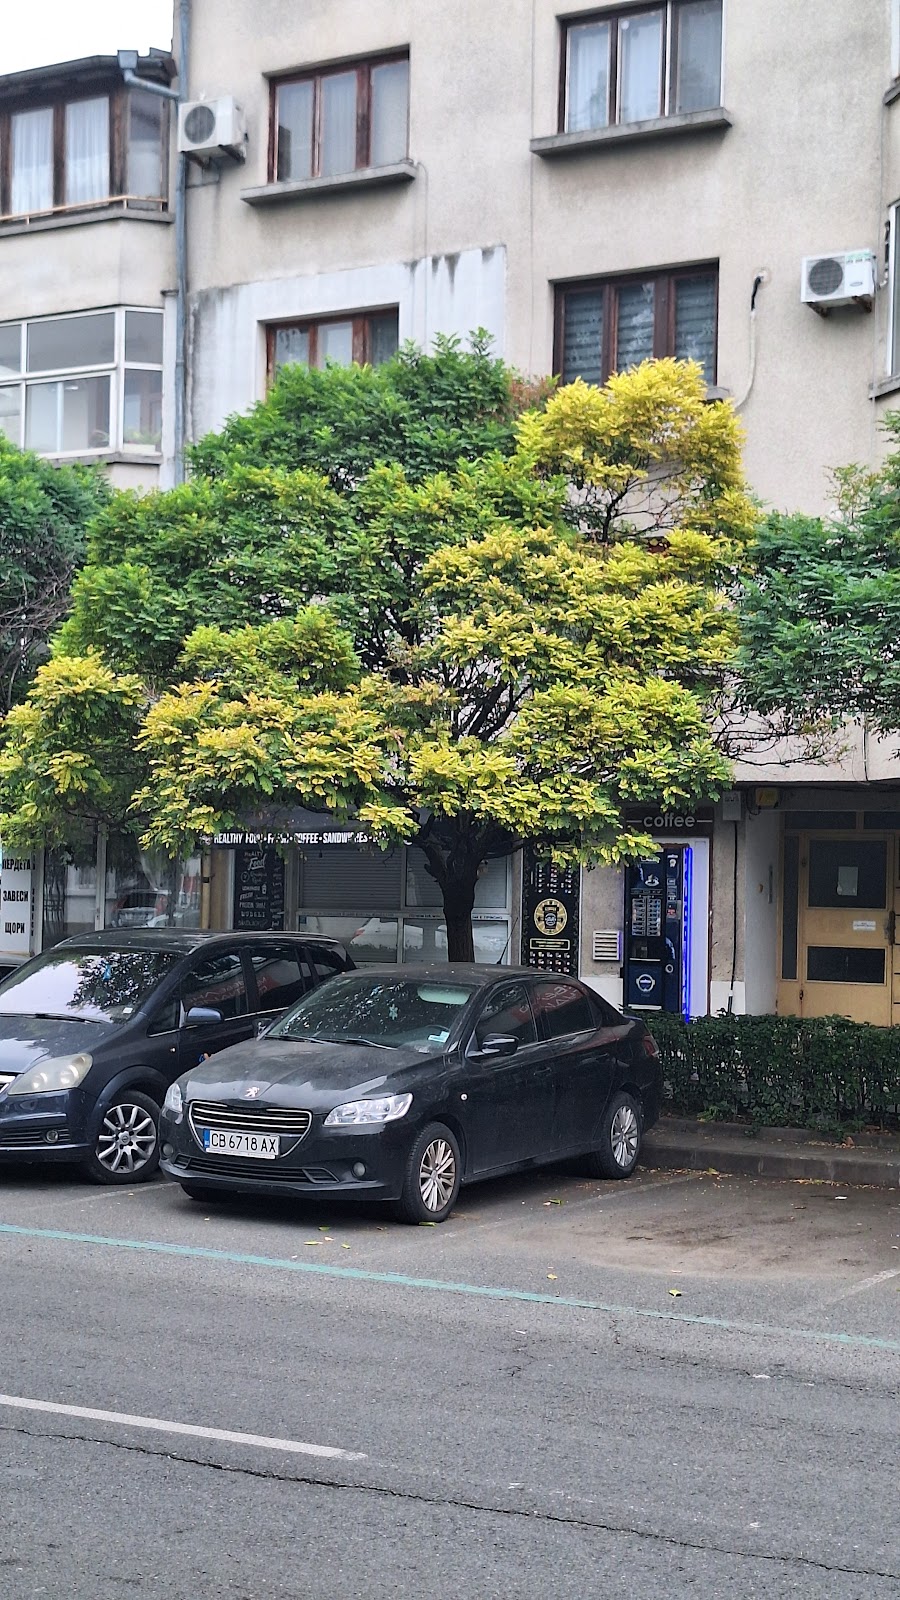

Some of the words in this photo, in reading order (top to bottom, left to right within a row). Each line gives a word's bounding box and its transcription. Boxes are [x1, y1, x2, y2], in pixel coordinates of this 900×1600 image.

[643, 813, 695, 827] coffee
[214, 832, 243, 844] HEALTHY
[3, 890, 28, 902] ЗАВЕСИ
[5, 922, 25, 934] ЩОРИ
[211, 1133, 226, 1148] CB
[229, 1135, 258, 1150] 6718
[261, 1138, 276, 1152] AX
